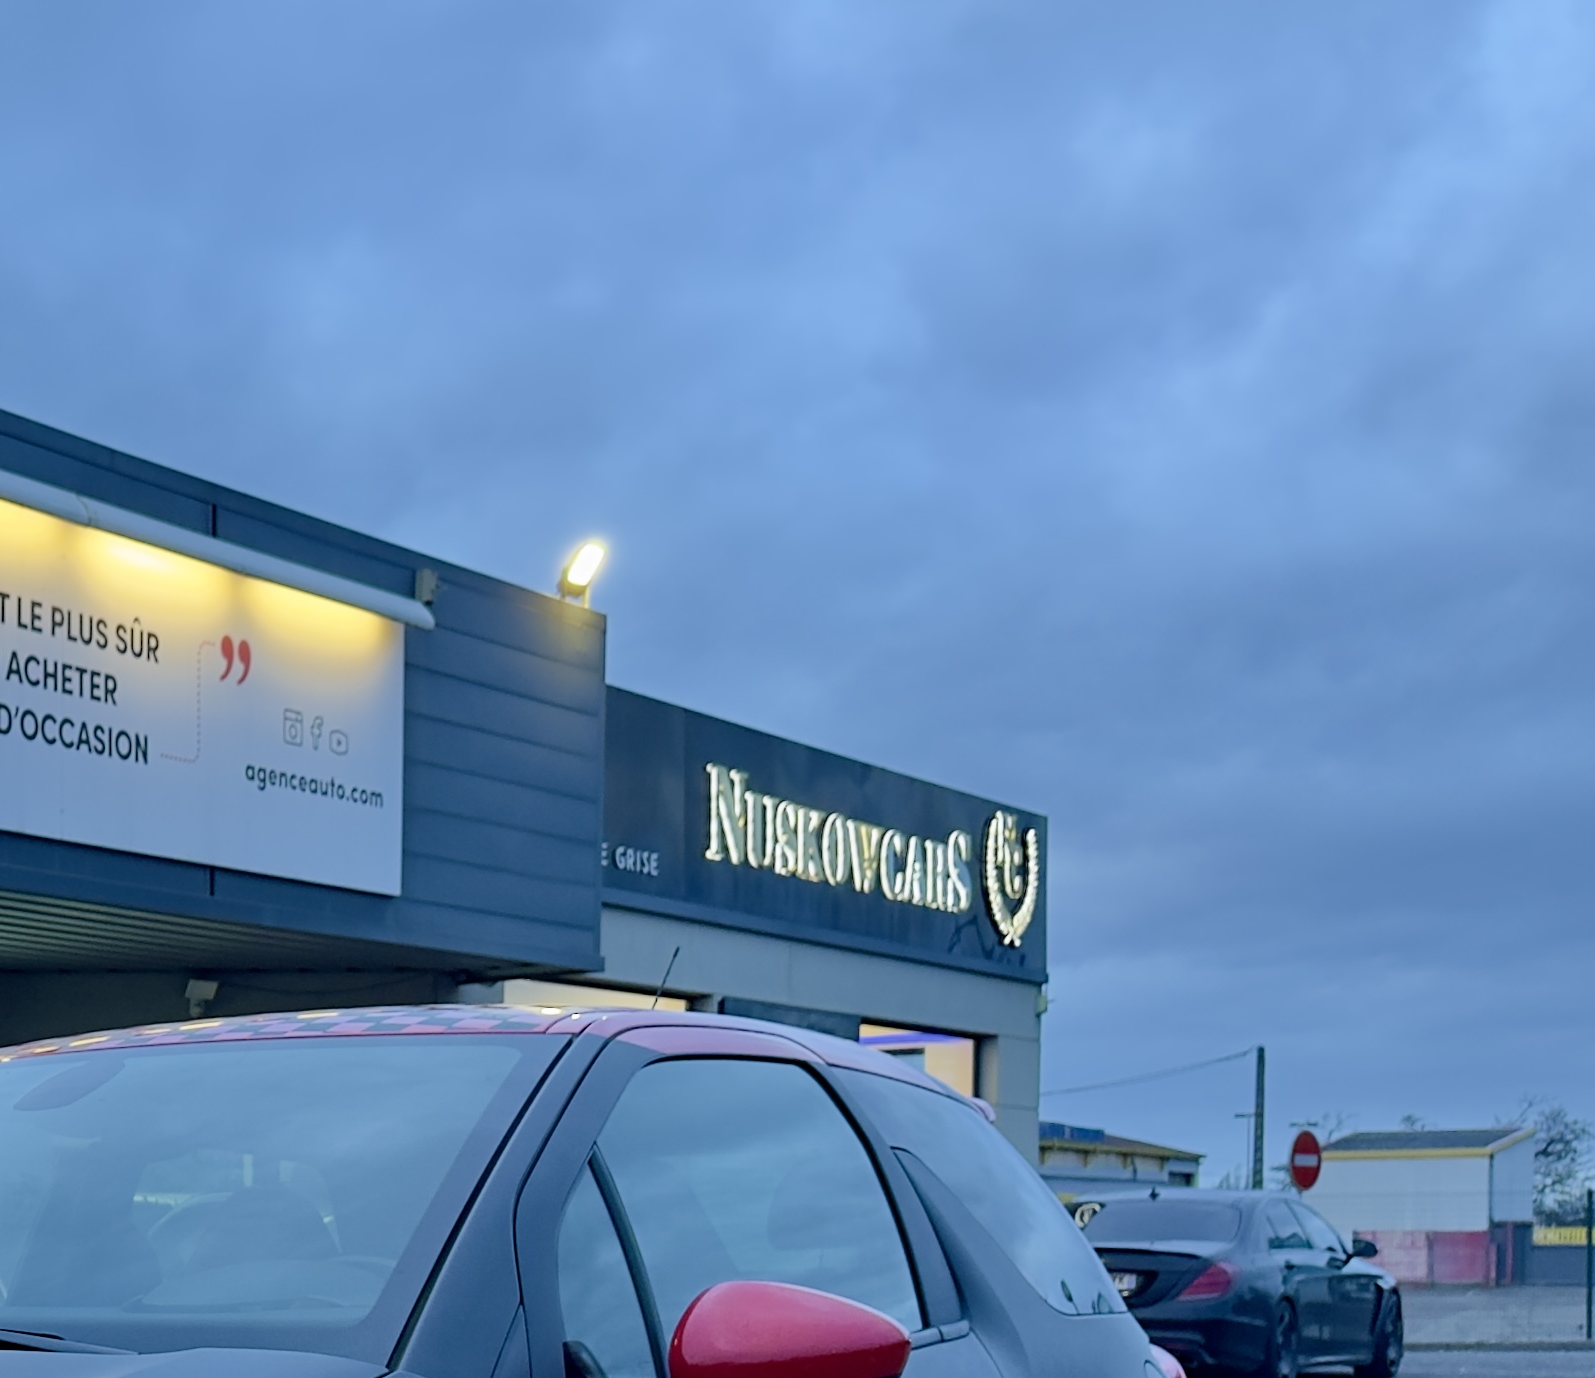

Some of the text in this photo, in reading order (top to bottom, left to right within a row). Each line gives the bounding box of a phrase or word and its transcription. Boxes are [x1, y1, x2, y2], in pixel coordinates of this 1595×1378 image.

[17, 597, 43, 631] LE
[52, 606, 108, 650] PLUS
[116, 617, 160, 663] SÛR
[5, 654, 118, 706] ACHETER
[245, 764, 384, 809] agenceauto.com
[615, 845, 660, 876] GRISE
